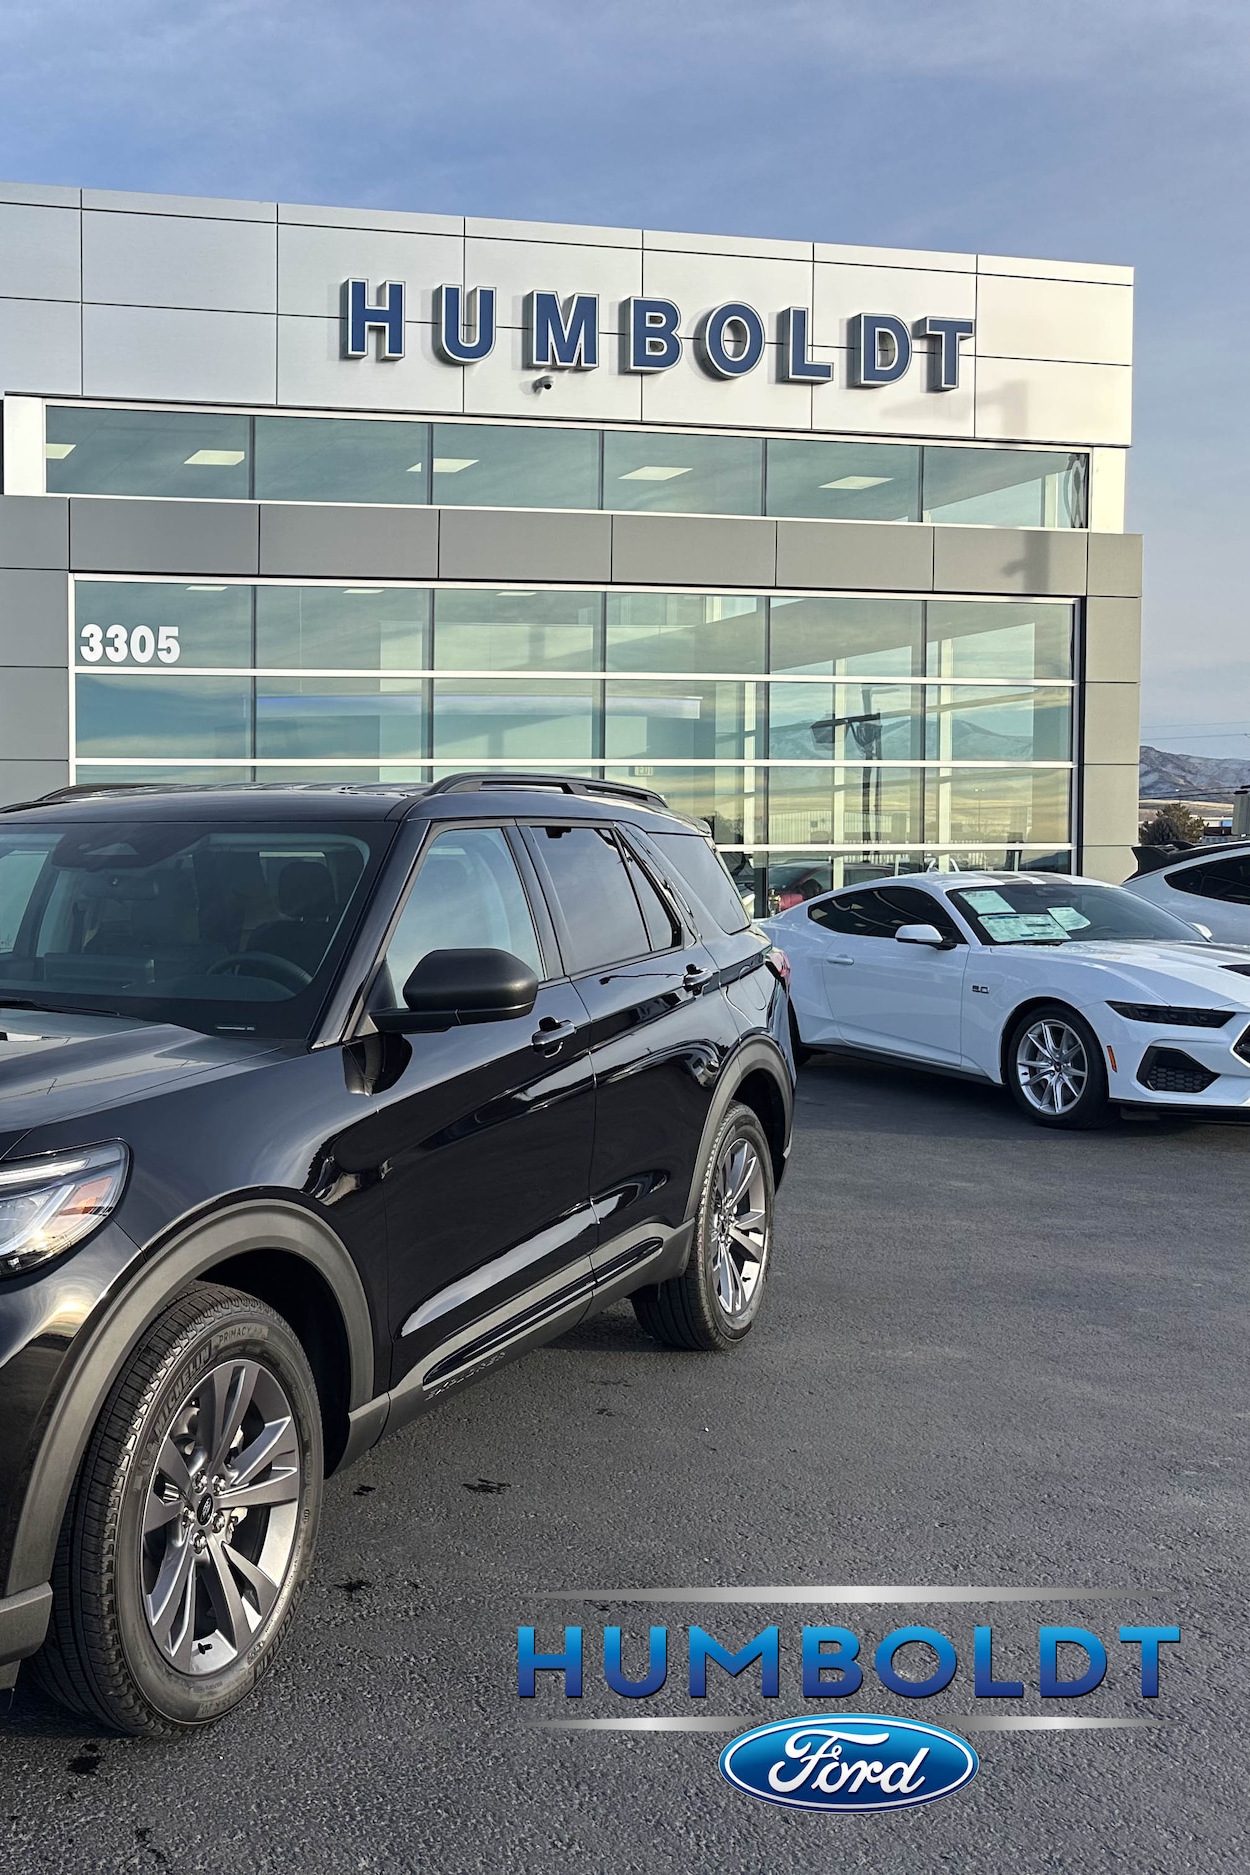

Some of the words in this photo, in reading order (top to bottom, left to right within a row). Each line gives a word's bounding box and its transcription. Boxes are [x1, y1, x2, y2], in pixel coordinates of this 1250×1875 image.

[343, 277, 976, 391] HUMBOLDT
[80, 623, 181, 664] 3305
[154, 1344, 211, 1439] MICHELIN
